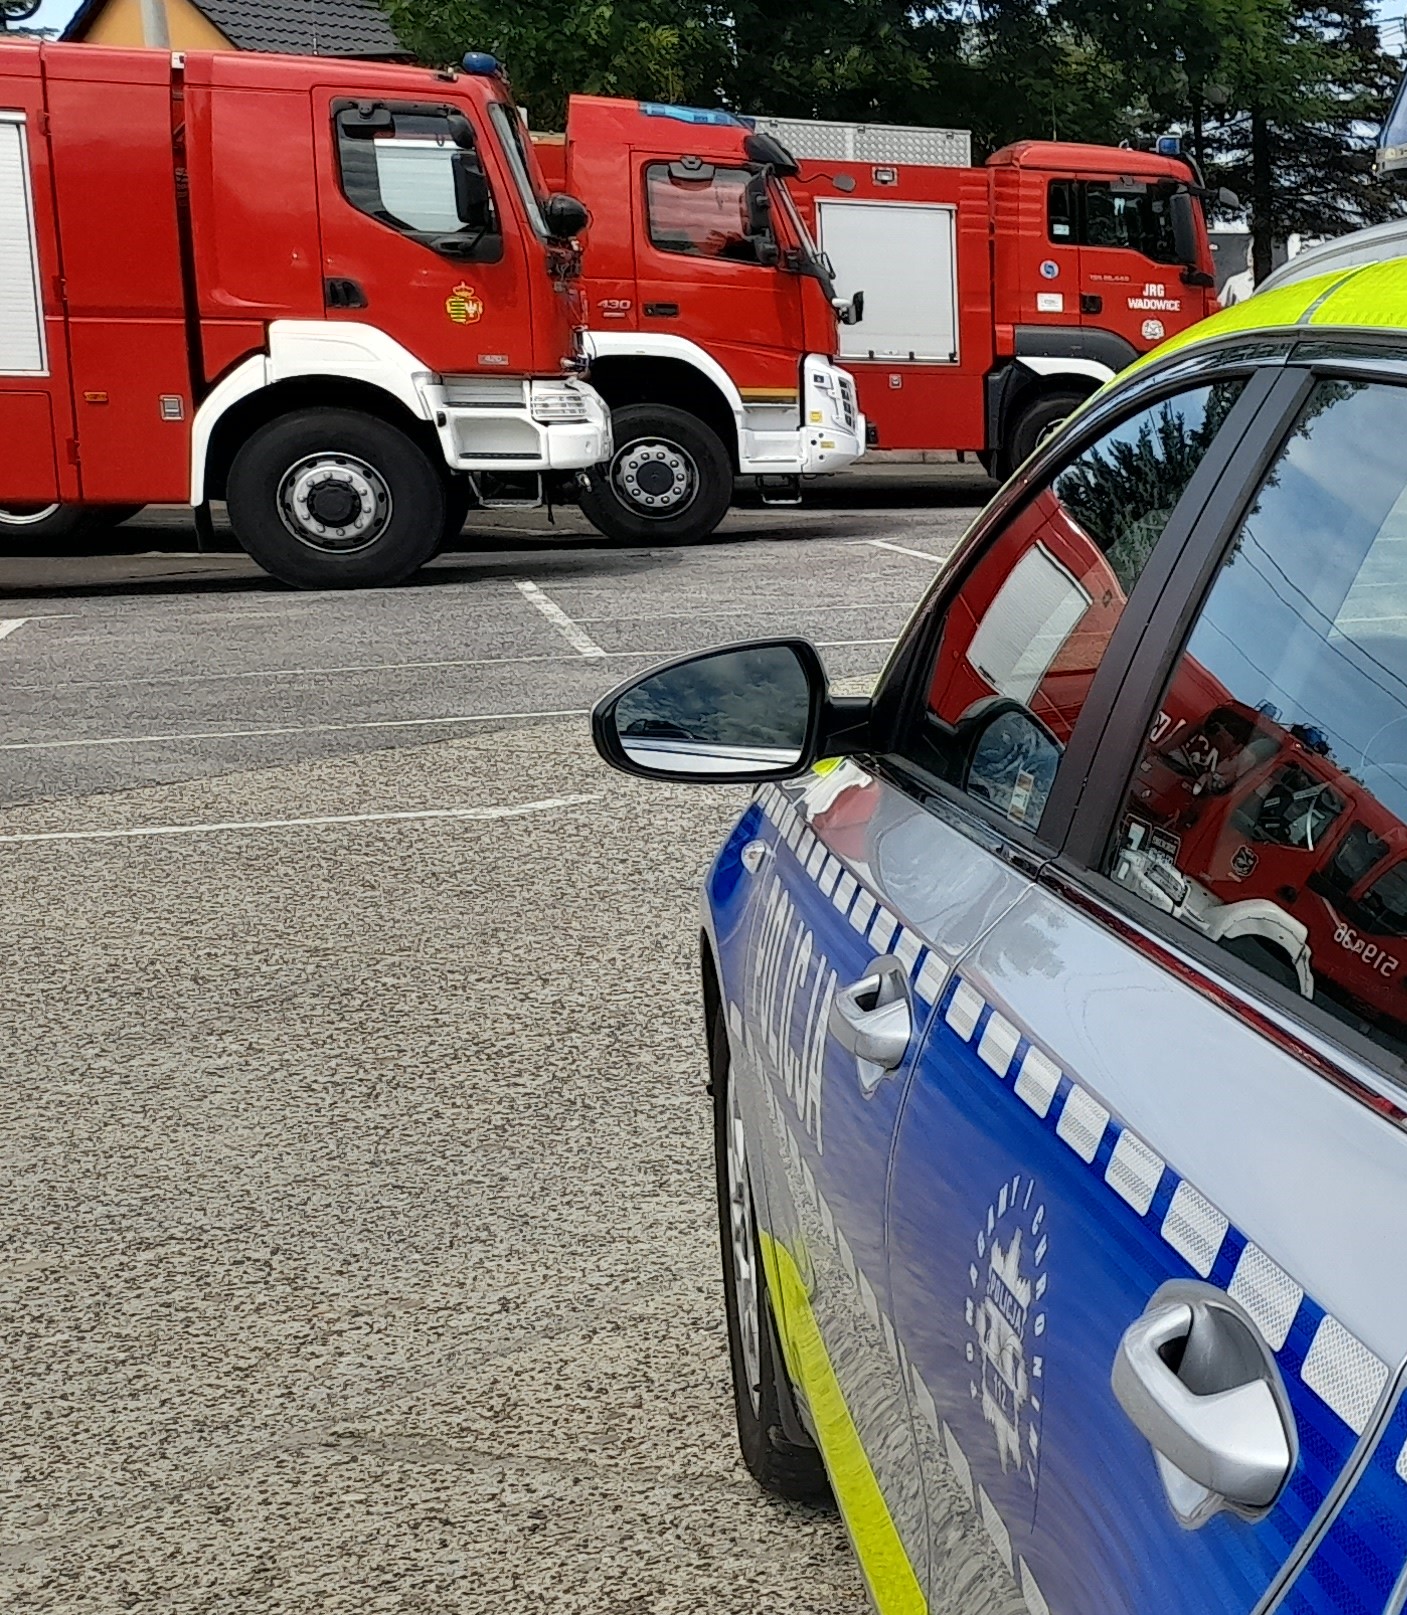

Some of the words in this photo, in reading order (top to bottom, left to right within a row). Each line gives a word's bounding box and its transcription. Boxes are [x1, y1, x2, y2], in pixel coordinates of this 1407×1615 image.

[1142, 283, 1165, 297] JRG
[597, 299, 632, 309] 430
[1127, 297, 1181, 311] WADOWICE
[752, 873, 838, 1157] POLICJA
[988, 1272, 1023, 1335] POLICJA
